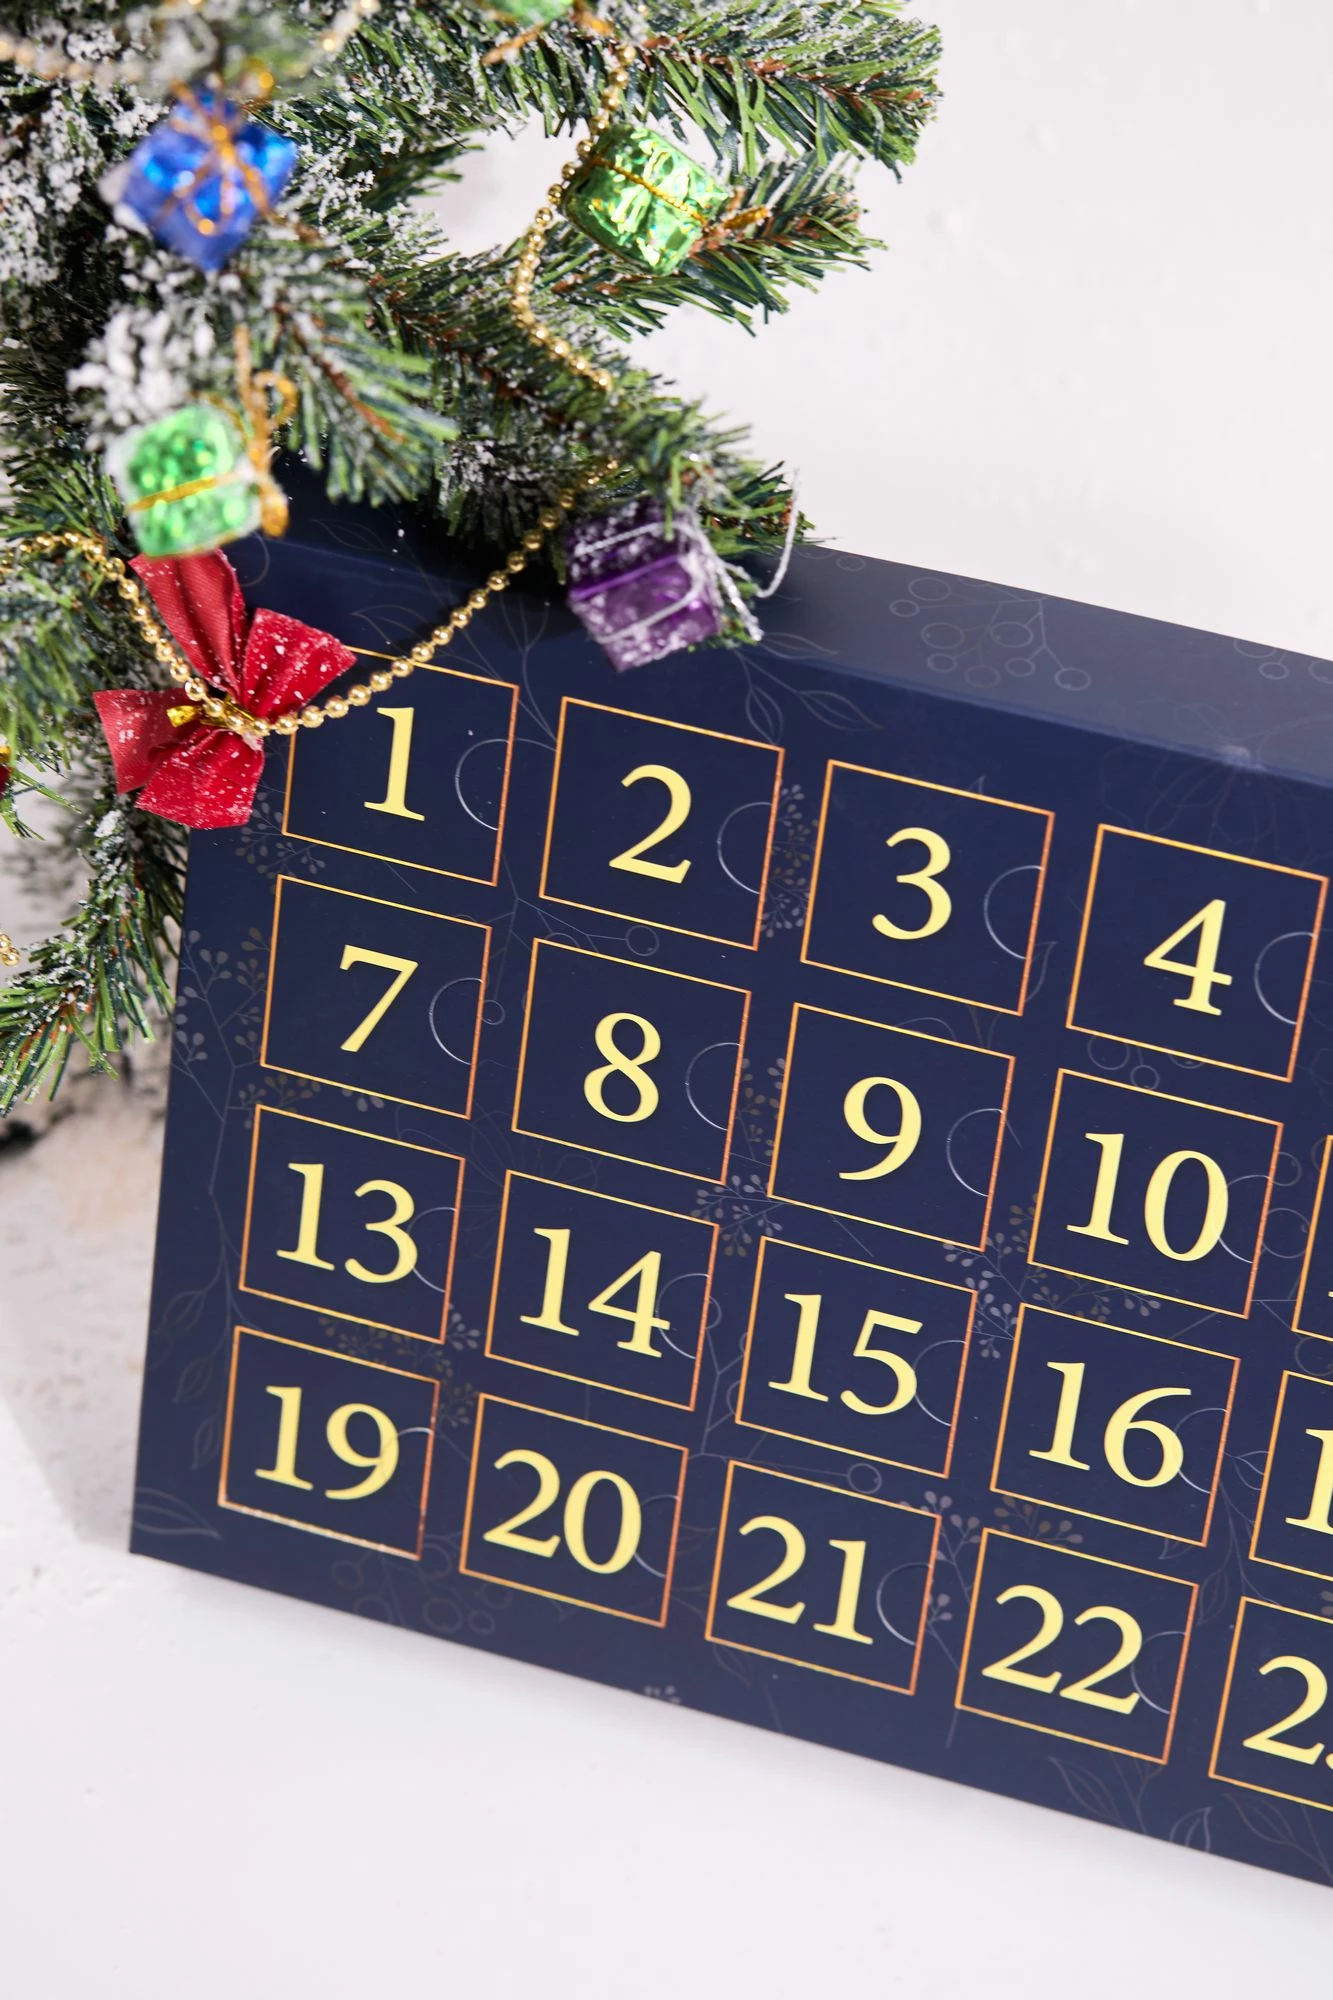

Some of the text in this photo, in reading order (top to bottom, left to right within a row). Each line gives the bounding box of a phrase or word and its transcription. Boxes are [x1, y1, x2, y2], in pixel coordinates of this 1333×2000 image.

[364, 706, 426, 822] 1
[608, 763, 692, 885] 2
[871, 826, 952, 941] 3
[339, 943, 419, 1054] 7
[1142, 898, 1233, 1017] 4
[582, 1011, 662, 1123] 8
[838, 1075, 922, 1181] 9
[276, 1162, 419, 1284] 13
[1066, 1132, 1228, 1262] 10
[520, 1226, 671, 1358] 14
[767, 1292, 922, 1415] 15
[254, 1384, 400, 1500] 19
[1027, 1360, 1190, 1488] 16
[1285, 1427, 1333, 1535] 1
[483, 1448, 642, 1574] 20
[726, 1514, 873, 1644] 21
[981, 1583, 1142, 1714] 22
[1242, 1654, 1333, 1770] 2
